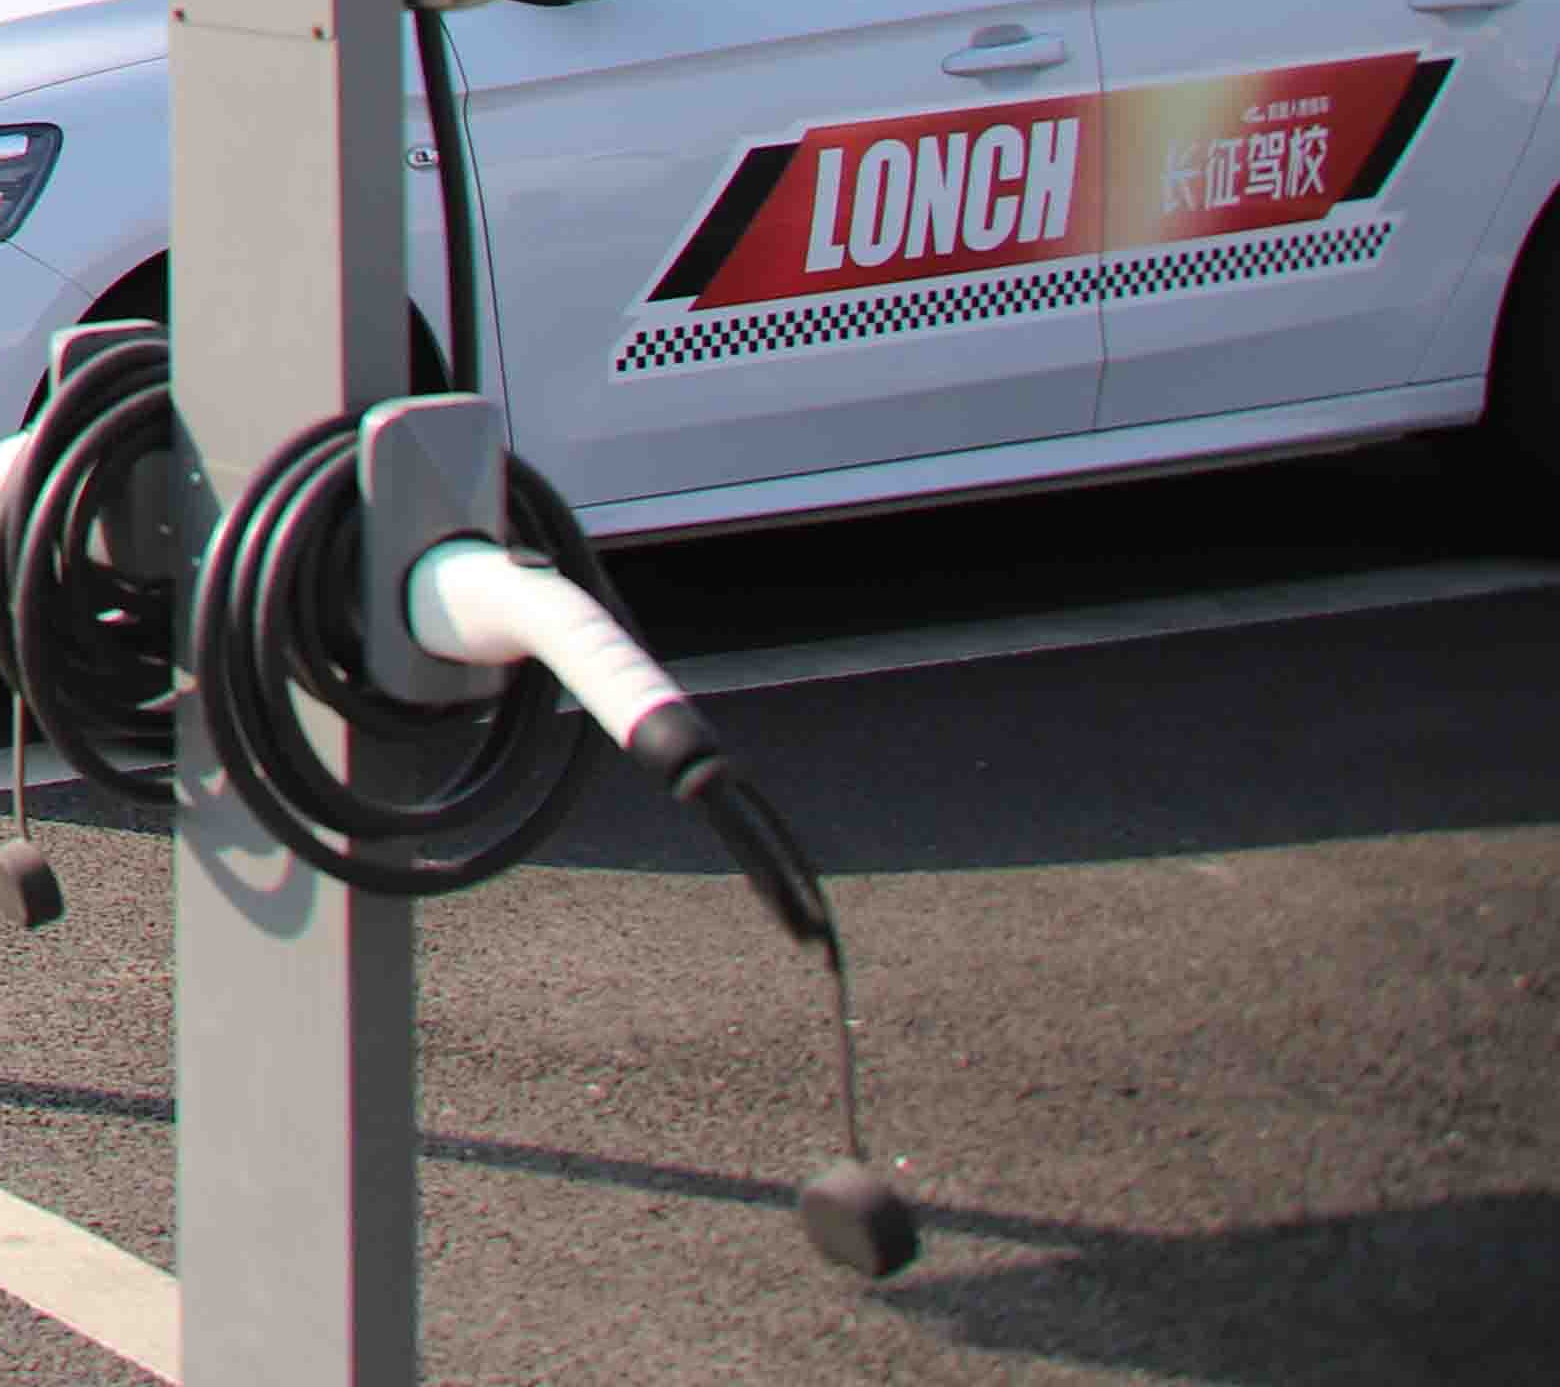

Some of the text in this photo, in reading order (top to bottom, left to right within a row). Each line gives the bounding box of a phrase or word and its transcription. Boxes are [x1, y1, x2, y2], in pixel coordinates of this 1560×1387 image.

[804, 117, 1080, 276] LONCH
[1161, 124, 1330, 214] 长征驾校
